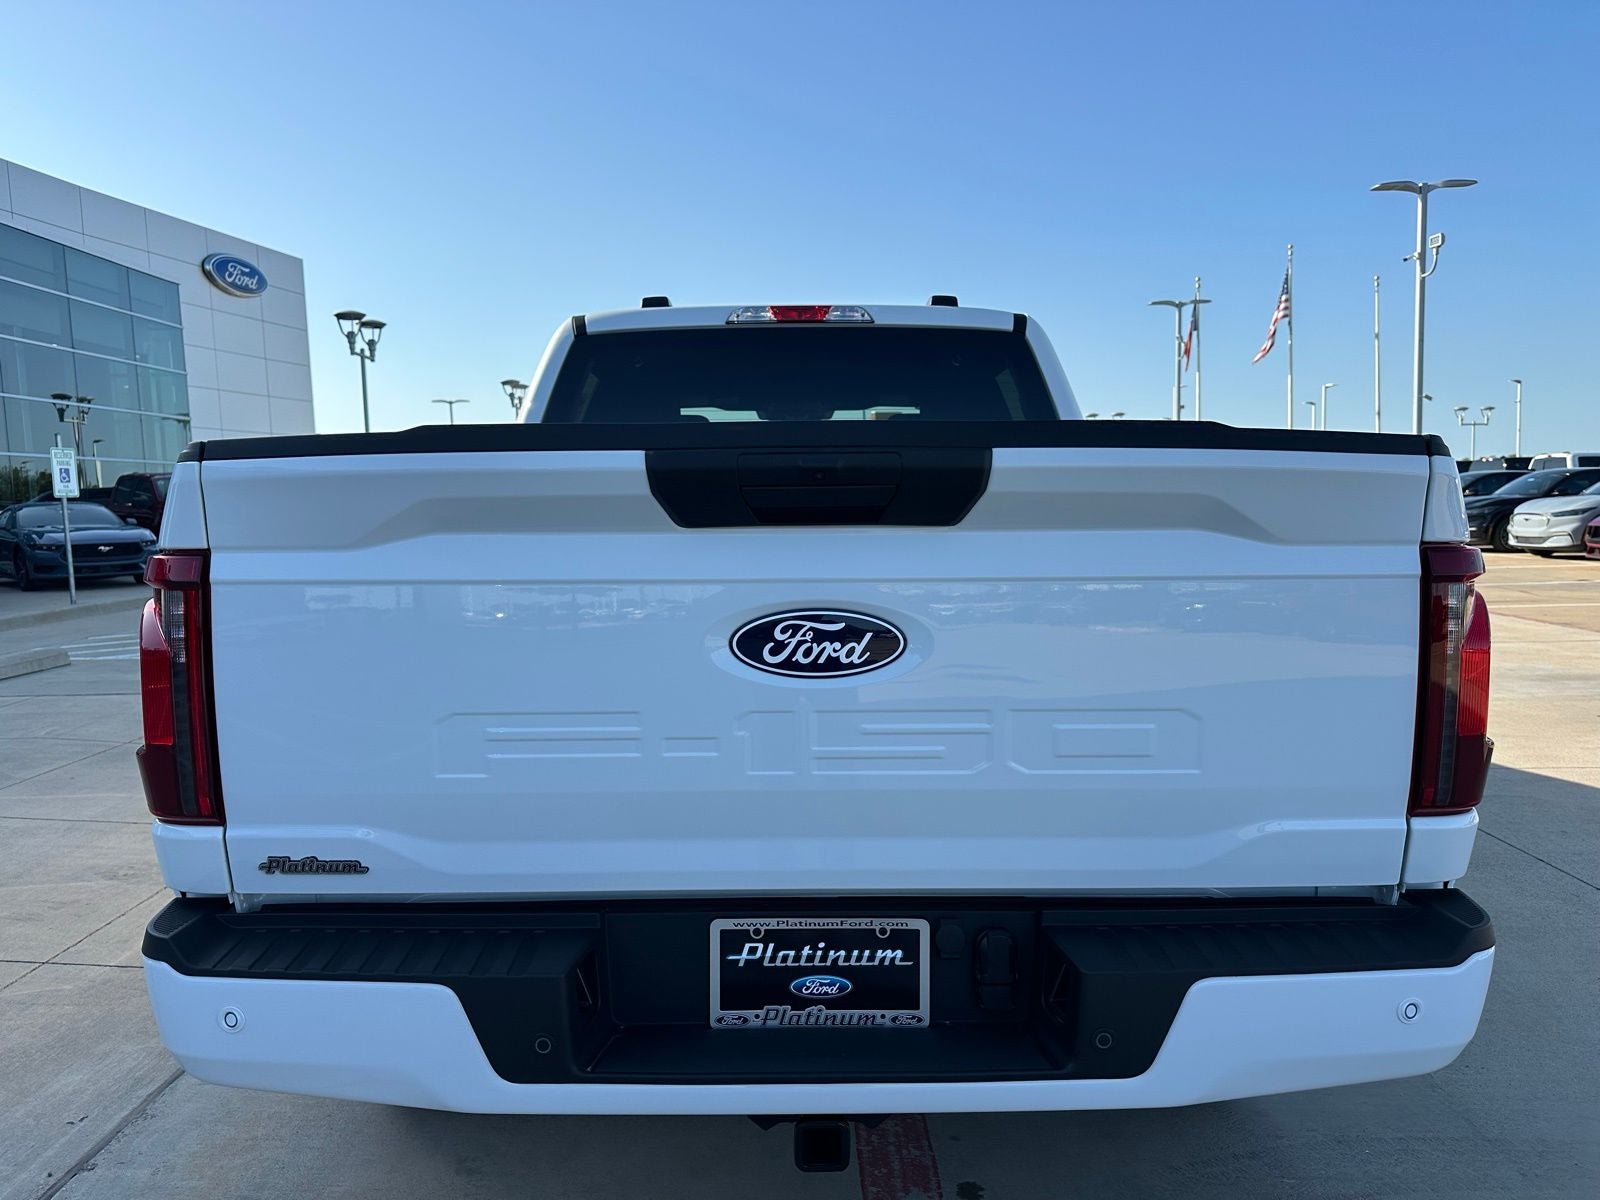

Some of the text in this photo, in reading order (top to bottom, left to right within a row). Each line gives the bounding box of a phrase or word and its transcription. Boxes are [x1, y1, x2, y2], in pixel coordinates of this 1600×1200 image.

[225, 262, 259, 289] Ford
[762, 621, 869, 666] Ford
[434, 709, 1203, 777] F-150
[258, 856, 369, 875] Platinum
[732, 919, 909, 928] www.PlatinumFord.com
[726, 942, 914, 967] Platinum
[802, 977, 840, 995] Ford
[721, 1006, 918, 1026] Ford Platinum Ford
